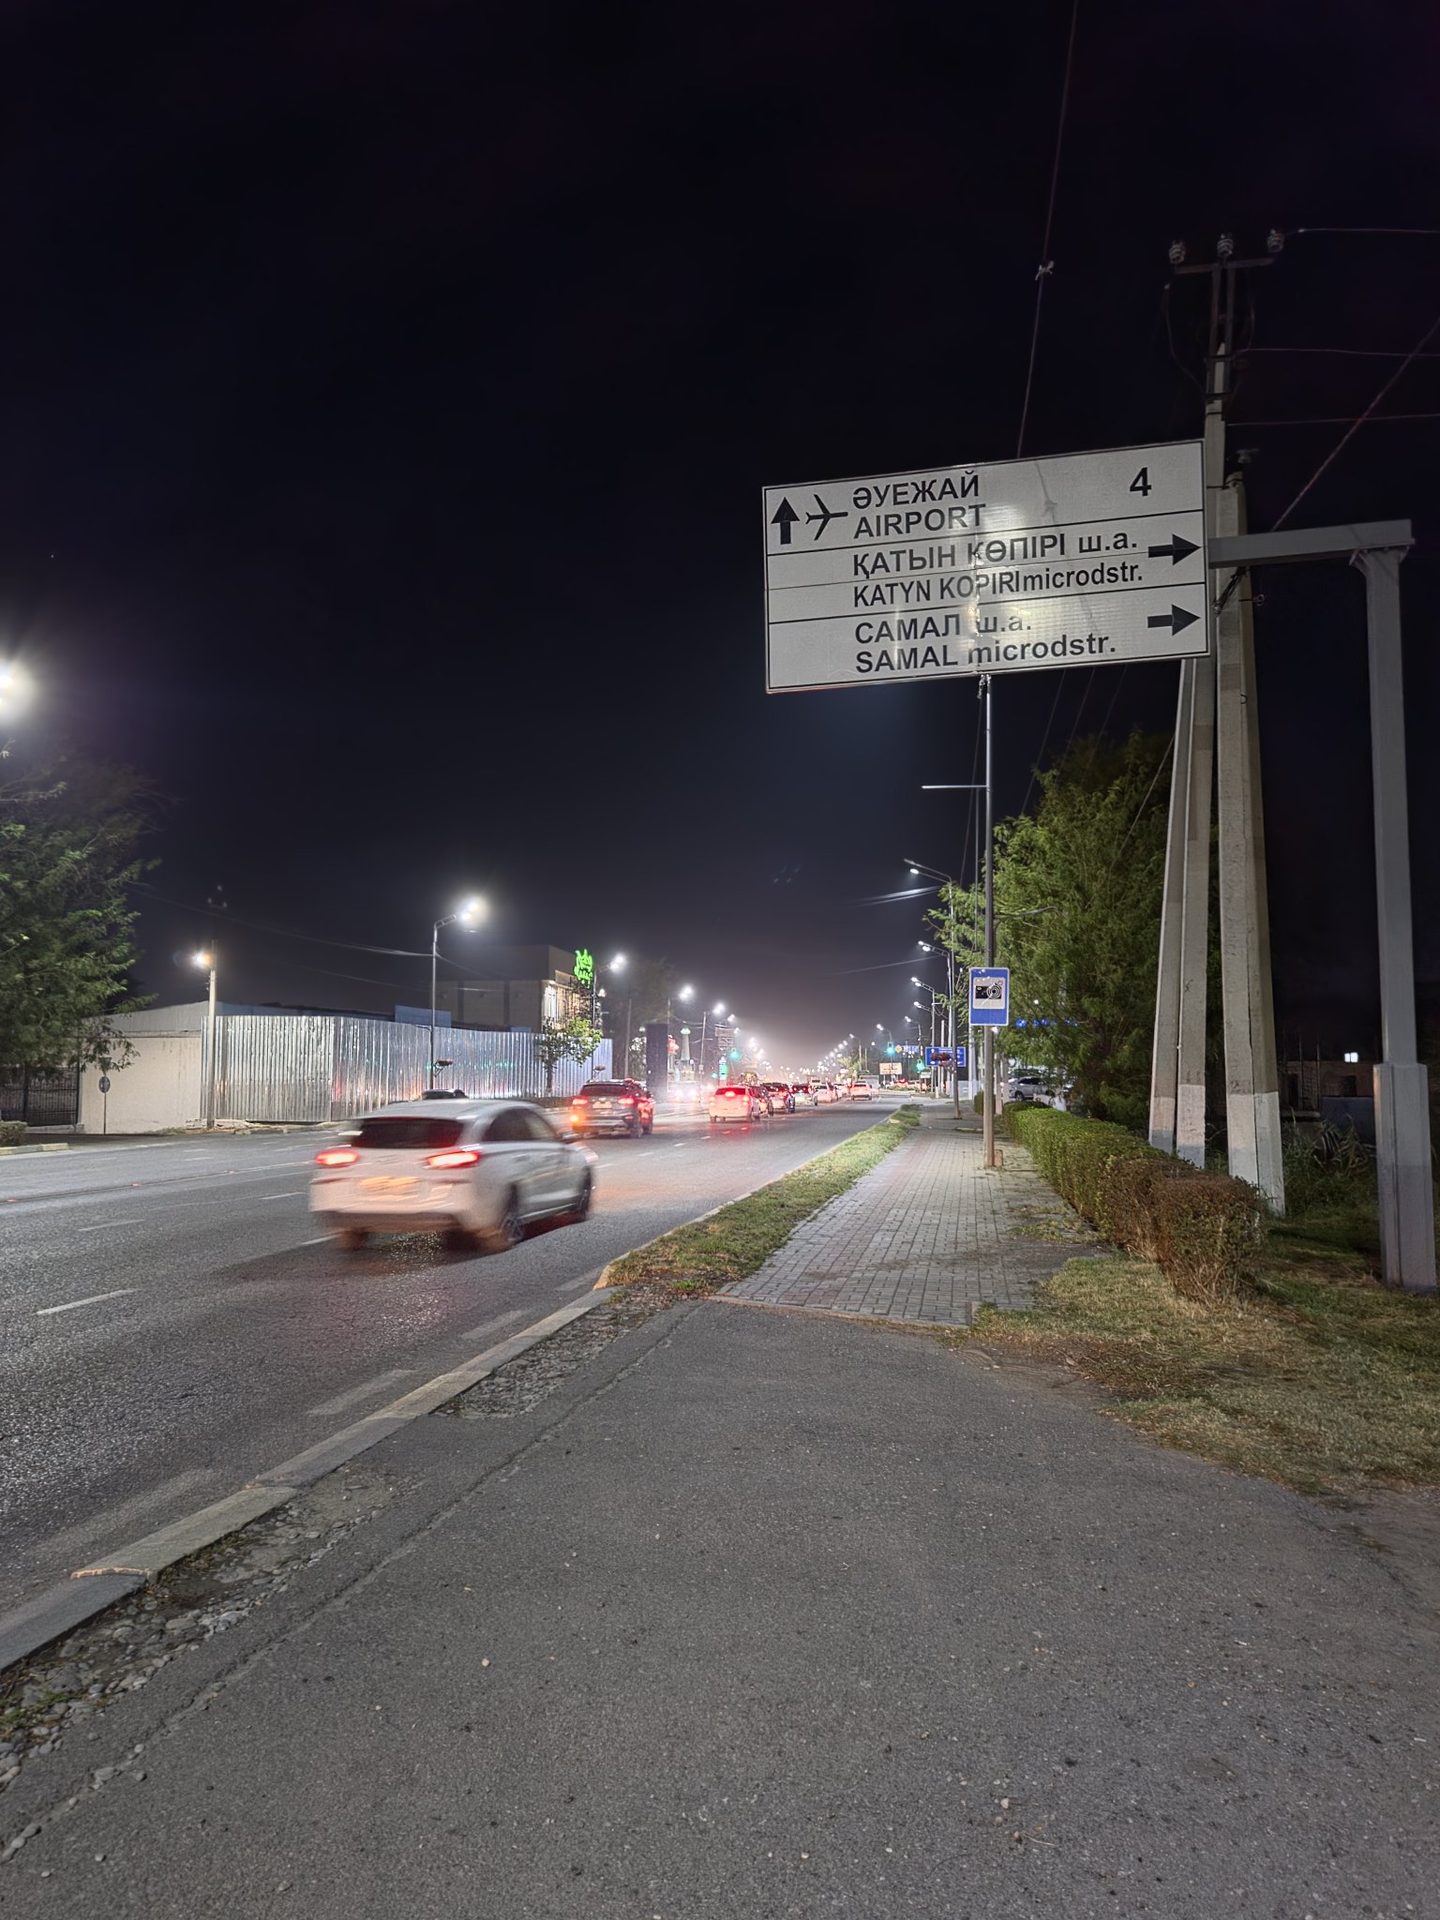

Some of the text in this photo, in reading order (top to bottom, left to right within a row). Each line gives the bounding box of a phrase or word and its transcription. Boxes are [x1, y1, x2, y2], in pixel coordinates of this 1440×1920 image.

[852, 470, 979, 510] ӘУЕЖАЙ
[1129, 466, 1152, 497] 4
[853, 503, 986, 539] AIRPORT
[853, 545, 956, 579] ҚАТЫН
[1078, 532, 1137, 554] ш.а.
[854, 560, 1143, 608] KATYN KOPIRI microdstr.
[855, 613, 1032, 644] САМАЛ ш.а.
[855, 632, 1116, 674] SAMAL microdstr.
